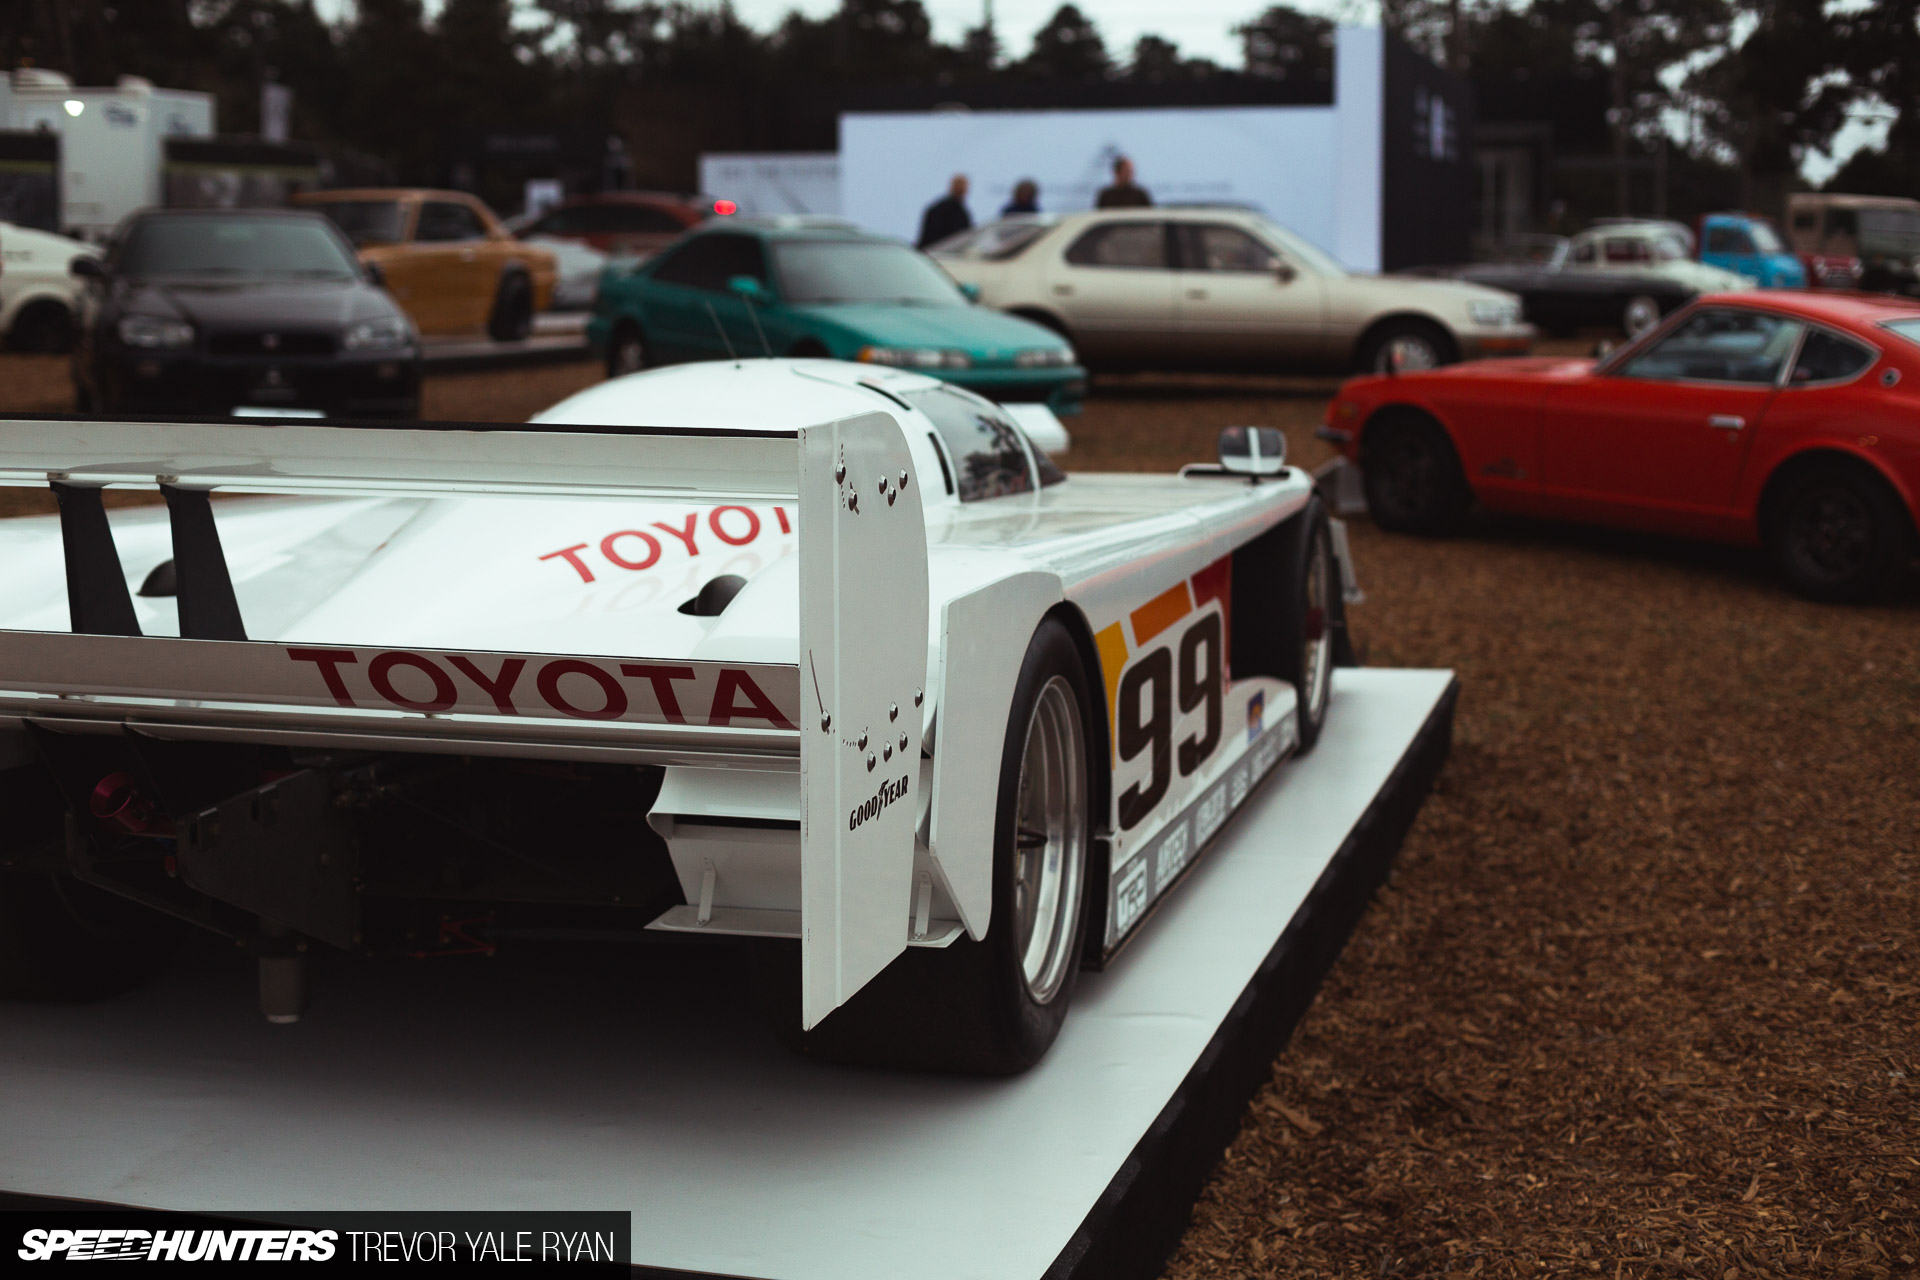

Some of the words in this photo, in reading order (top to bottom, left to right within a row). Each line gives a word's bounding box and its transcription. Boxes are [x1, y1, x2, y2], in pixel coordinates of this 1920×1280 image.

[287, 647, 800, 730] TOYOTA
[1118, 611, 1223, 831] 99
[849, 774, 909, 831] GOODYEAR
